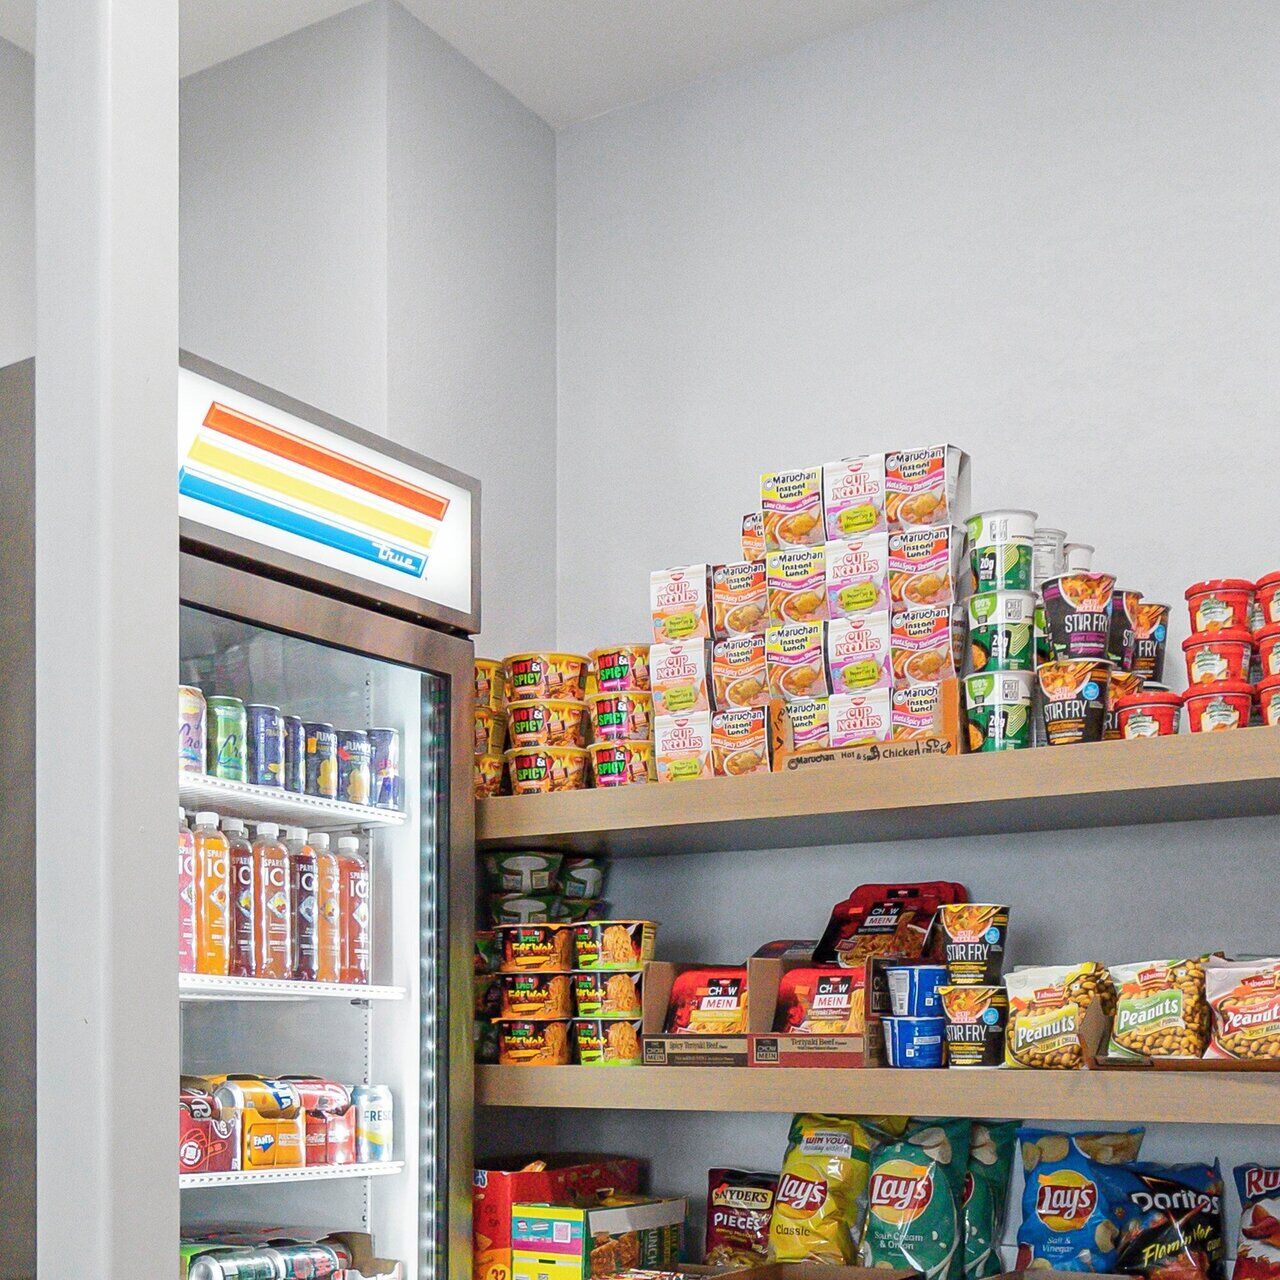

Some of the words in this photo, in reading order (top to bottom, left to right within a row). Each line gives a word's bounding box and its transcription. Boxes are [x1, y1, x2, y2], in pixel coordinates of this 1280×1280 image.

[896, 449, 942, 463] Maruchan
[773, 472, 817, 485] Maruchan
[842, 472, 869, 486] CUP
[832, 483, 880, 501] NOODLES
[901, 531, 947, 543] Maruchan
[779, 551, 823, 563] Maruchan
[842, 552, 869, 565] CUP
[721, 564, 766, 577] Maruchan
[832, 560, 880, 579] NOODLES
[665, 582, 689, 595] CUP
[656, 591, 699, 606] NOODLES
[901, 607, 946, 620] Maruchan
[1065, 613, 1090, 633] STIR
[1091, 612, 1109, 631] FRY
[776, 625, 819, 639] Maruchan
[845, 629, 872, 643] CUP
[908, 626, 932, 636] Lunch
[722, 637, 764, 650] Maruchan
[782, 643, 805, 652] Lunch
[835, 639, 881, 656] NOODLES
[512, 659, 531, 673] HOT
[598, 653, 618, 668] HOT
[665, 655, 687, 669] CUP
[728, 655, 751, 664] Lunch
[514, 672, 541, 686] SPICY
[600, 667, 627, 680] SPICY
[656, 664, 697, 680] NOODLES
[513, 707, 534, 721] HOT
[597, 700, 617, 714] HOT
[846, 706, 872, 720] CUP
[1044, 702, 1065, 722] STIR
[1065, 699, 1087, 719] FRY
[599, 713, 626, 725] SPICY
[721, 711, 763, 722] Maruchan
[515, 720, 543, 733] SPICY
[836, 715, 882, 733] NOODLES
[670, 727, 692, 741] CUP
[727, 727, 750, 736] Lunch
[661, 735, 703, 751] NOODLES
[515, 755, 537, 769] HOT
[596, 750, 615, 763] HOT
[796, 753, 835, 765] Maruchan
[882, 747, 921, 758] Chicken
[517, 768, 545, 781] SPICY
[599, 763, 624, 775] SPICY
[870, 917, 893, 926] MEIN
[946, 944, 966, 961] STIR
[967, 944, 988, 961] FRY
[706, 998, 733, 1008] MEIN
[818, 997, 844, 1006] MEIN
[1120, 998, 1179, 1029] Peanuts
[946, 1025, 966, 1041] STIR
[968, 1024, 987, 1041] FRY
[1018, 1015, 1076, 1047] Peanuts
[791, 1038, 818, 1048] Teriyaki
[806, 1137, 823, 1145] WIN
[778, 1174, 824, 1210] Lay's
[871, 1174, 926, 1210] Lay's
[1039, 1184, 1093, 1214] Lay's
[1131, 1191, 1220, 1216] Doritos
[714, 1212, 760, 1231] PIECES
[776, 1224, 810, 1237] Classic
[874, 1232, 891, 1241] Sour
[893, 1232, 923, 1242] Cream
[1191, 1224, 1212, 1242] Hot
[888, 1241, 914, 1250] Onion
[1042, 1244, 1073, 1253] Vinegar
